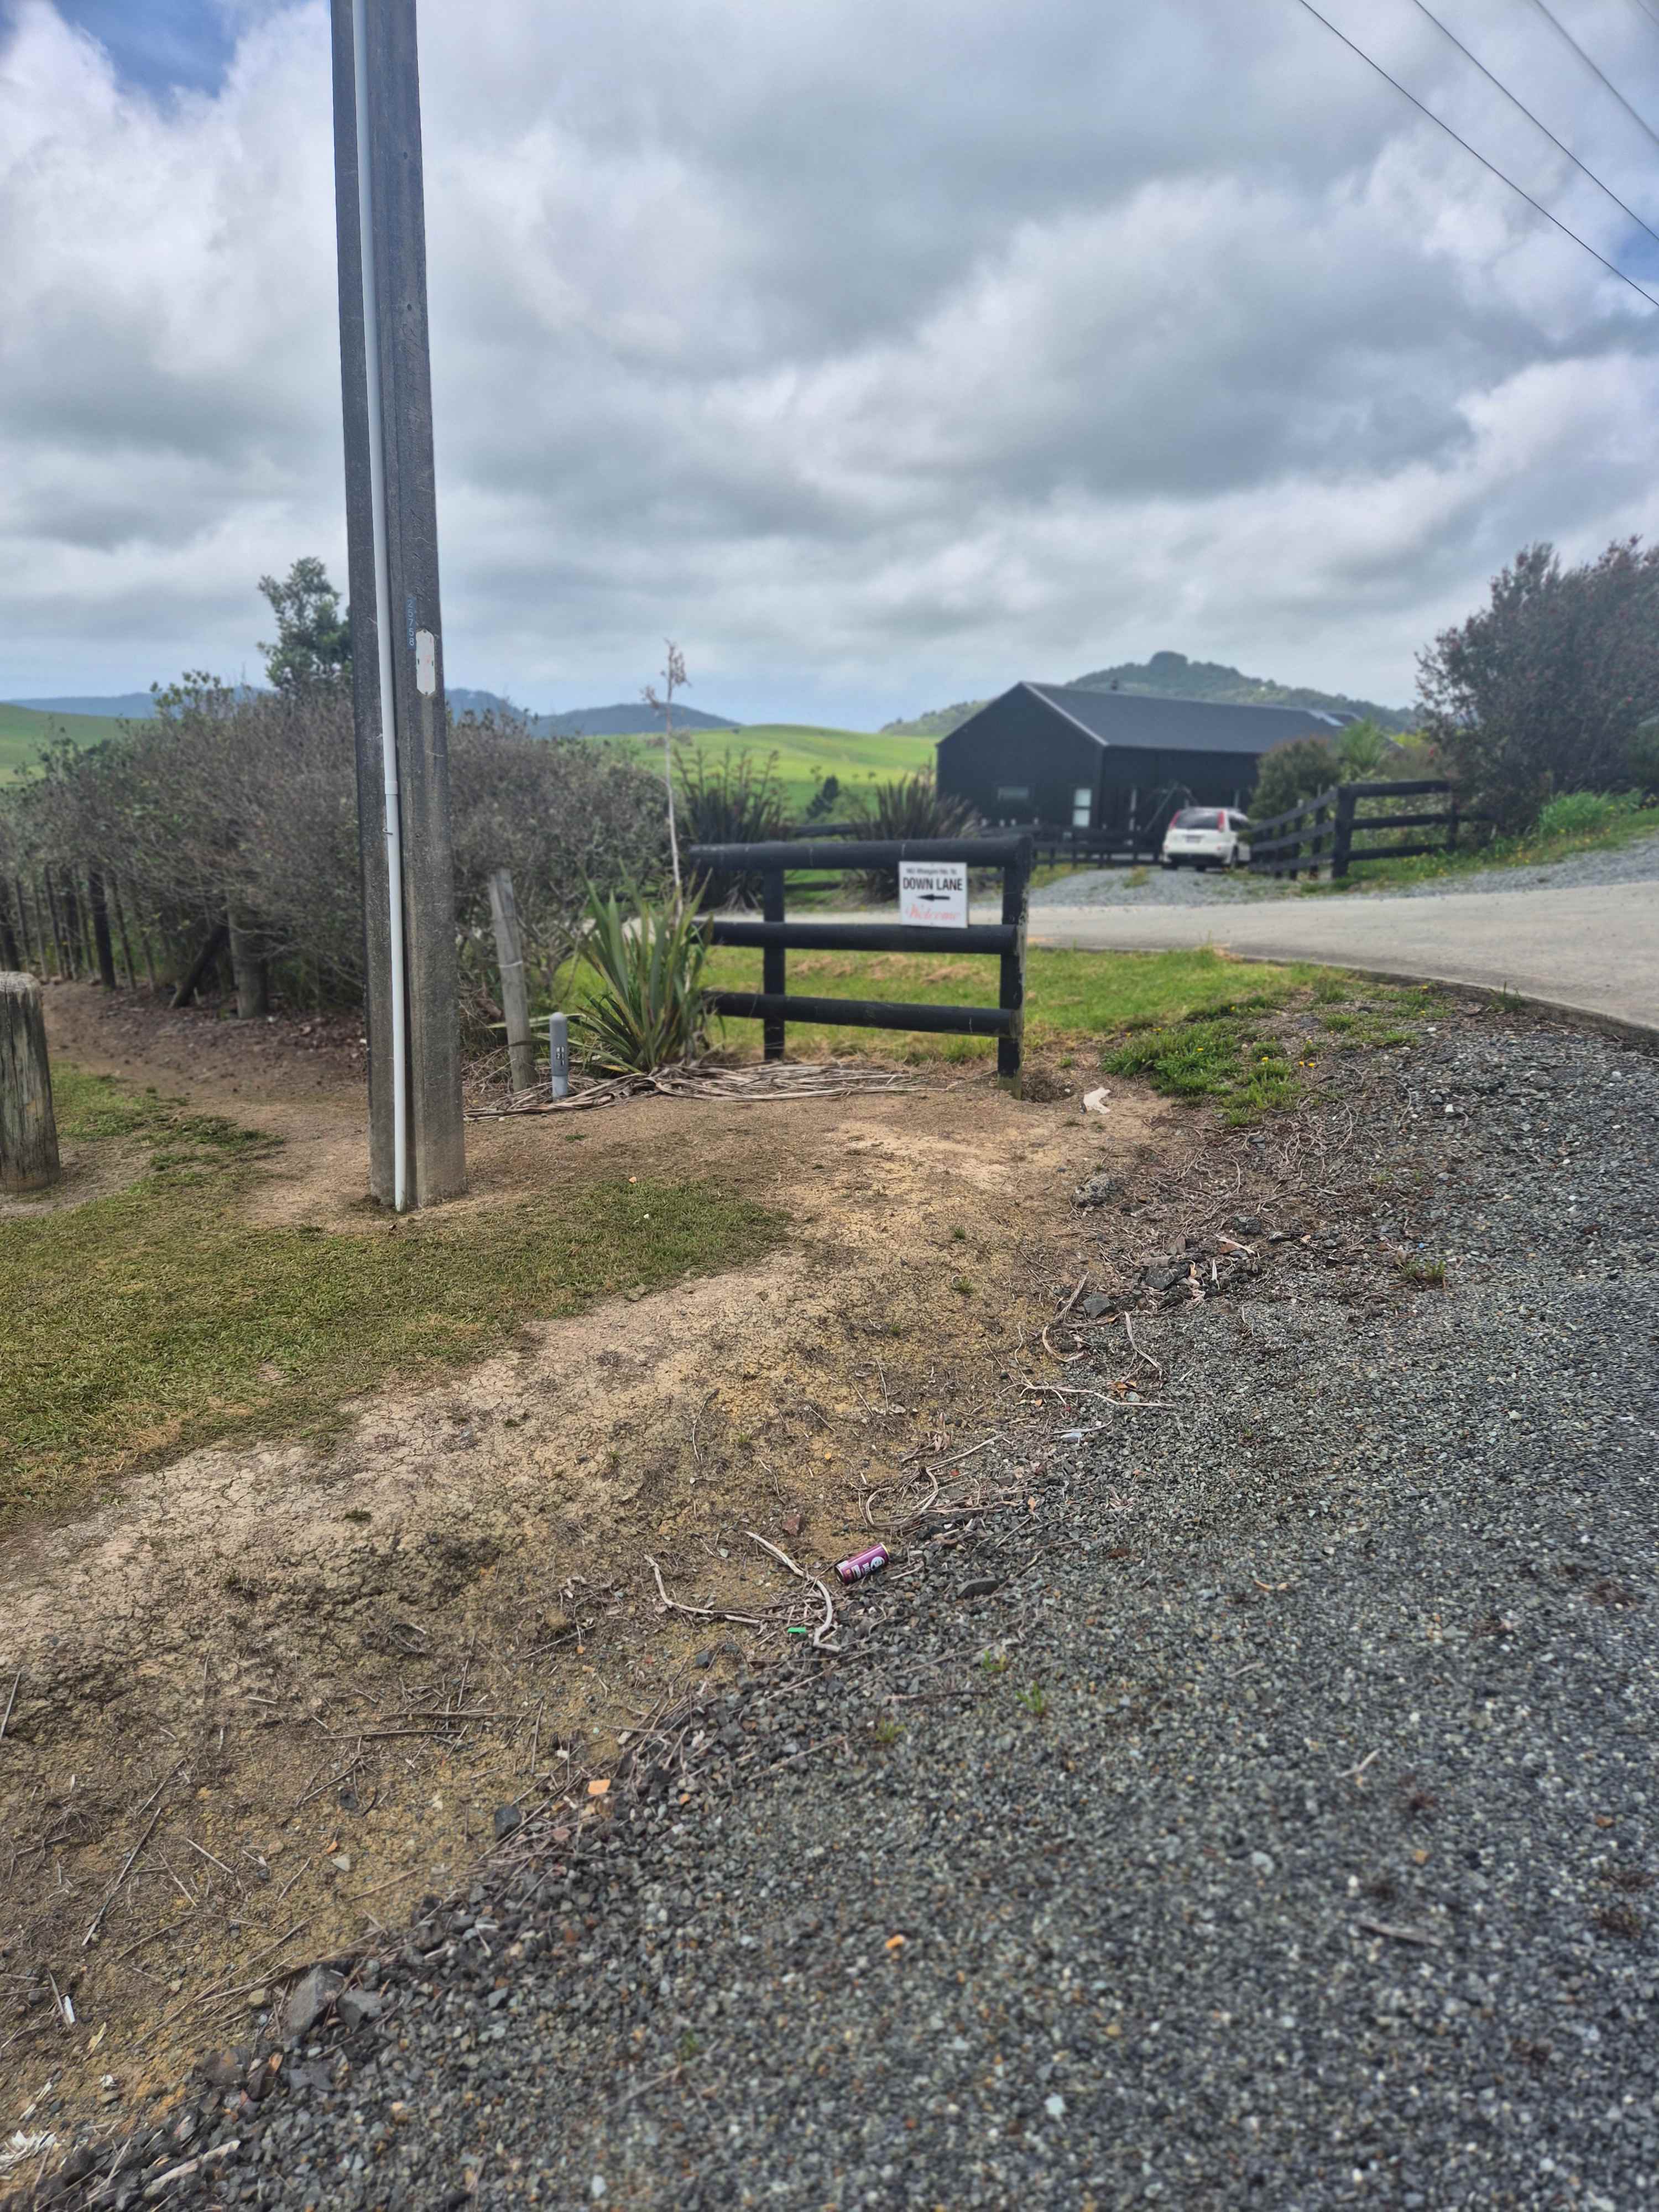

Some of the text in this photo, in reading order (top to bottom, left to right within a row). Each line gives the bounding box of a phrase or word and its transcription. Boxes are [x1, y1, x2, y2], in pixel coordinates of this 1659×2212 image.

[406, 599, 415, 646] 25758
[903, 877, 963, 891] DOWN LANE
